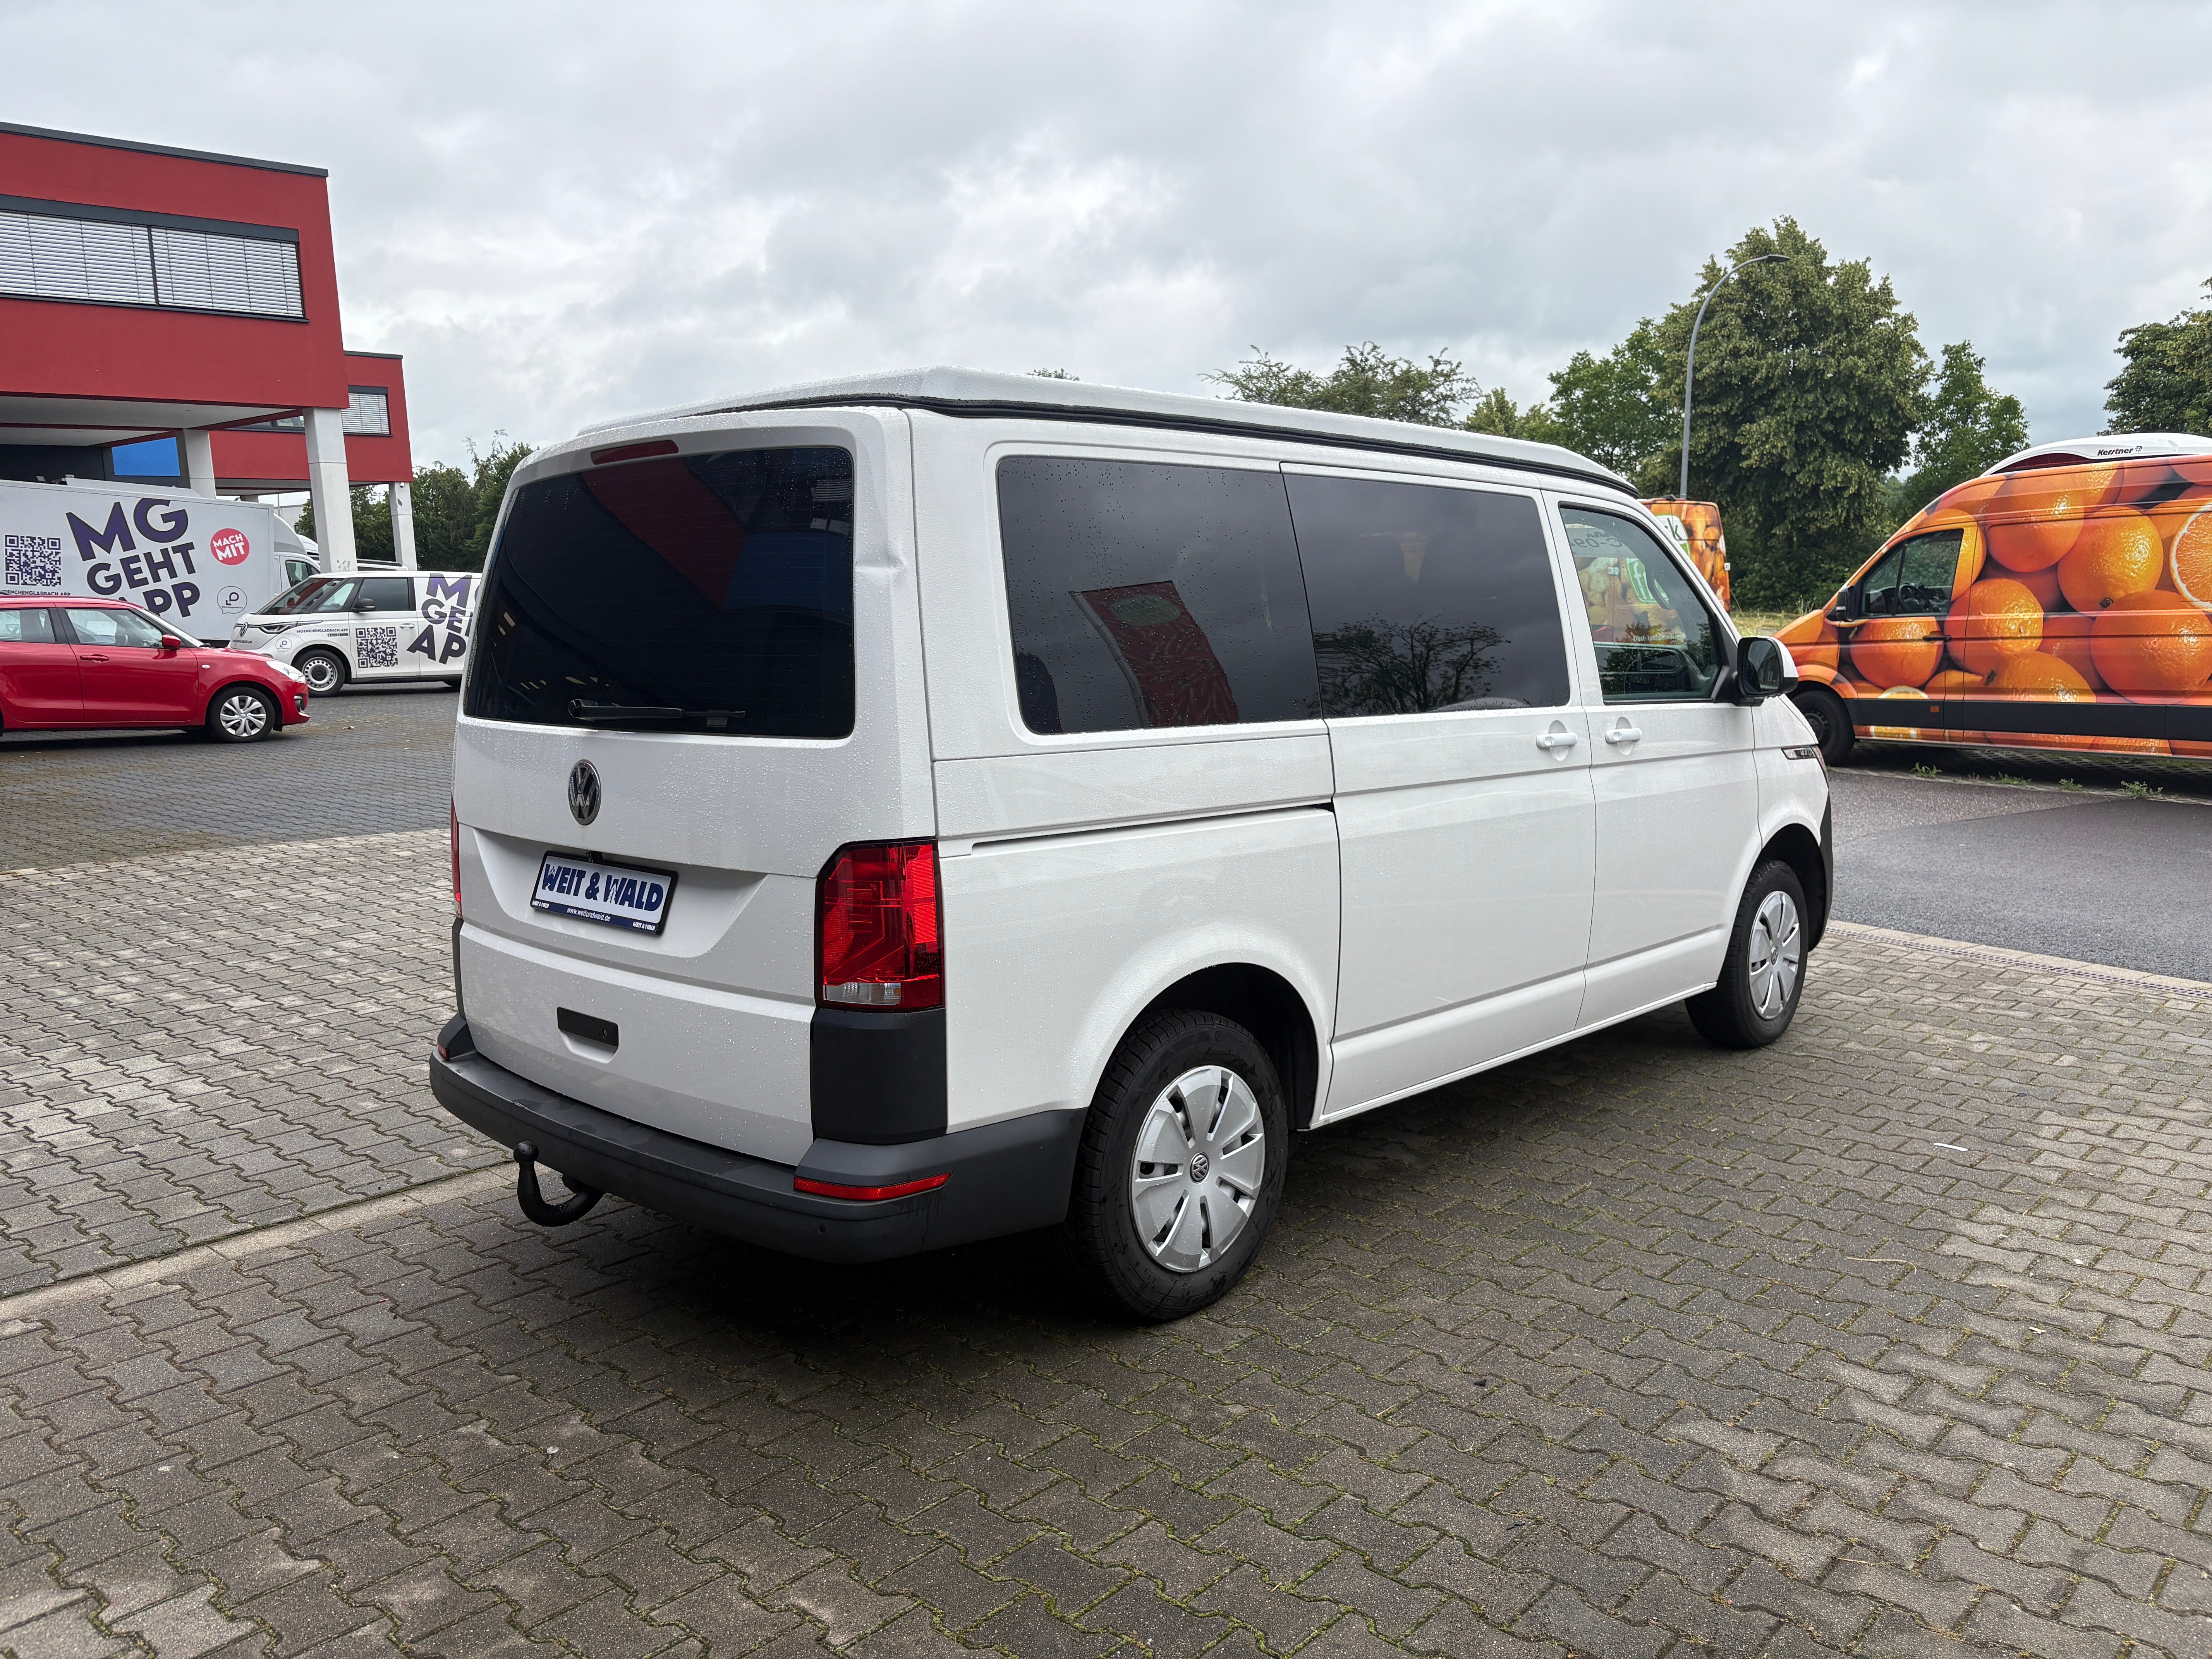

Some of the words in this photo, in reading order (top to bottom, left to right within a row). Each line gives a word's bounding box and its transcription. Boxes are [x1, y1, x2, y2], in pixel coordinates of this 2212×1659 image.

[66, 498, 189, 562] MG
[212, 534, 244, 548] MACH
[86, 542, 196, 595] GEHT
[215, 542, 245, 560] MIT
[119, 582, 200, 618] PP
[426, 573, 479, 609] M
[541, 864, 586, 896] WEIT
[585, 872, 600, 901] &
[603, 874, 664, 912] WALD
[567, 907, 611, 922] www.weitundwald.de
